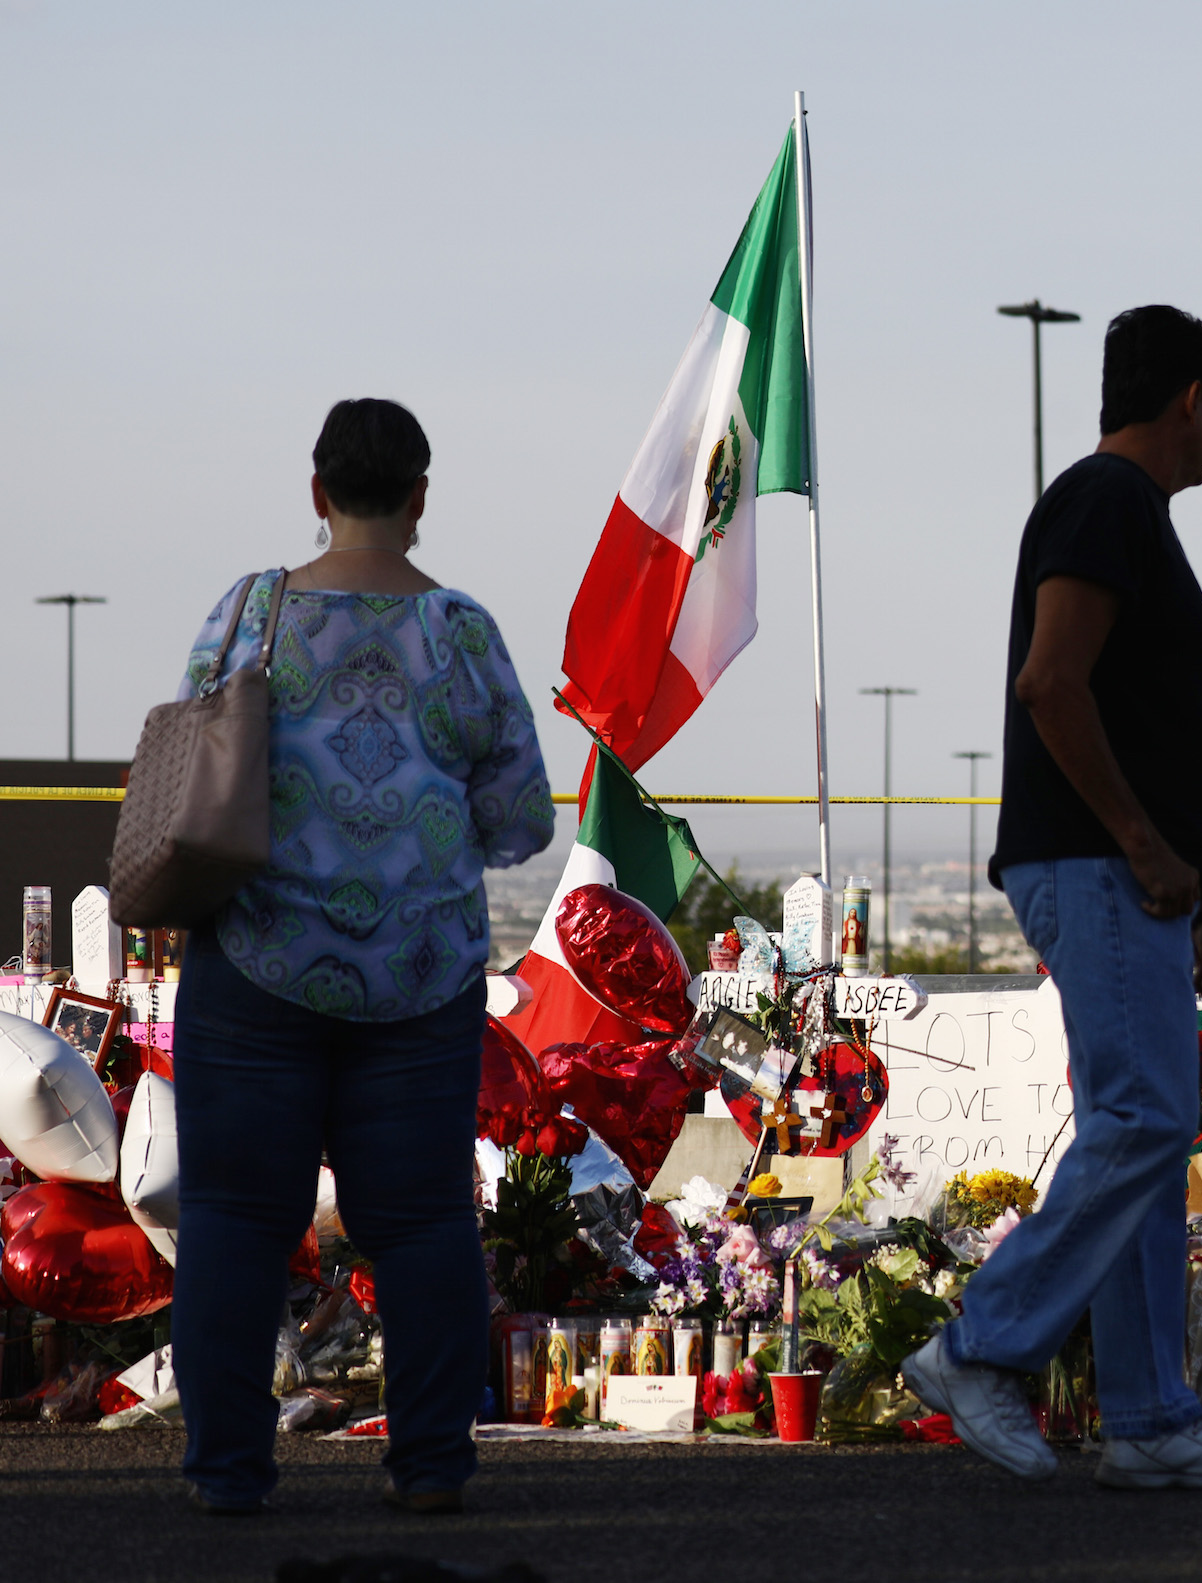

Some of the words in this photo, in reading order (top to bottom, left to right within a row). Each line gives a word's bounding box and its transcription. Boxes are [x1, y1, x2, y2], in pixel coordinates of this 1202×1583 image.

[886, 1008, 1037, 1073] LOTS
[886, 1086, 1003, 1122] LOVE
[878, 1134, 1005, 1168] FROM
